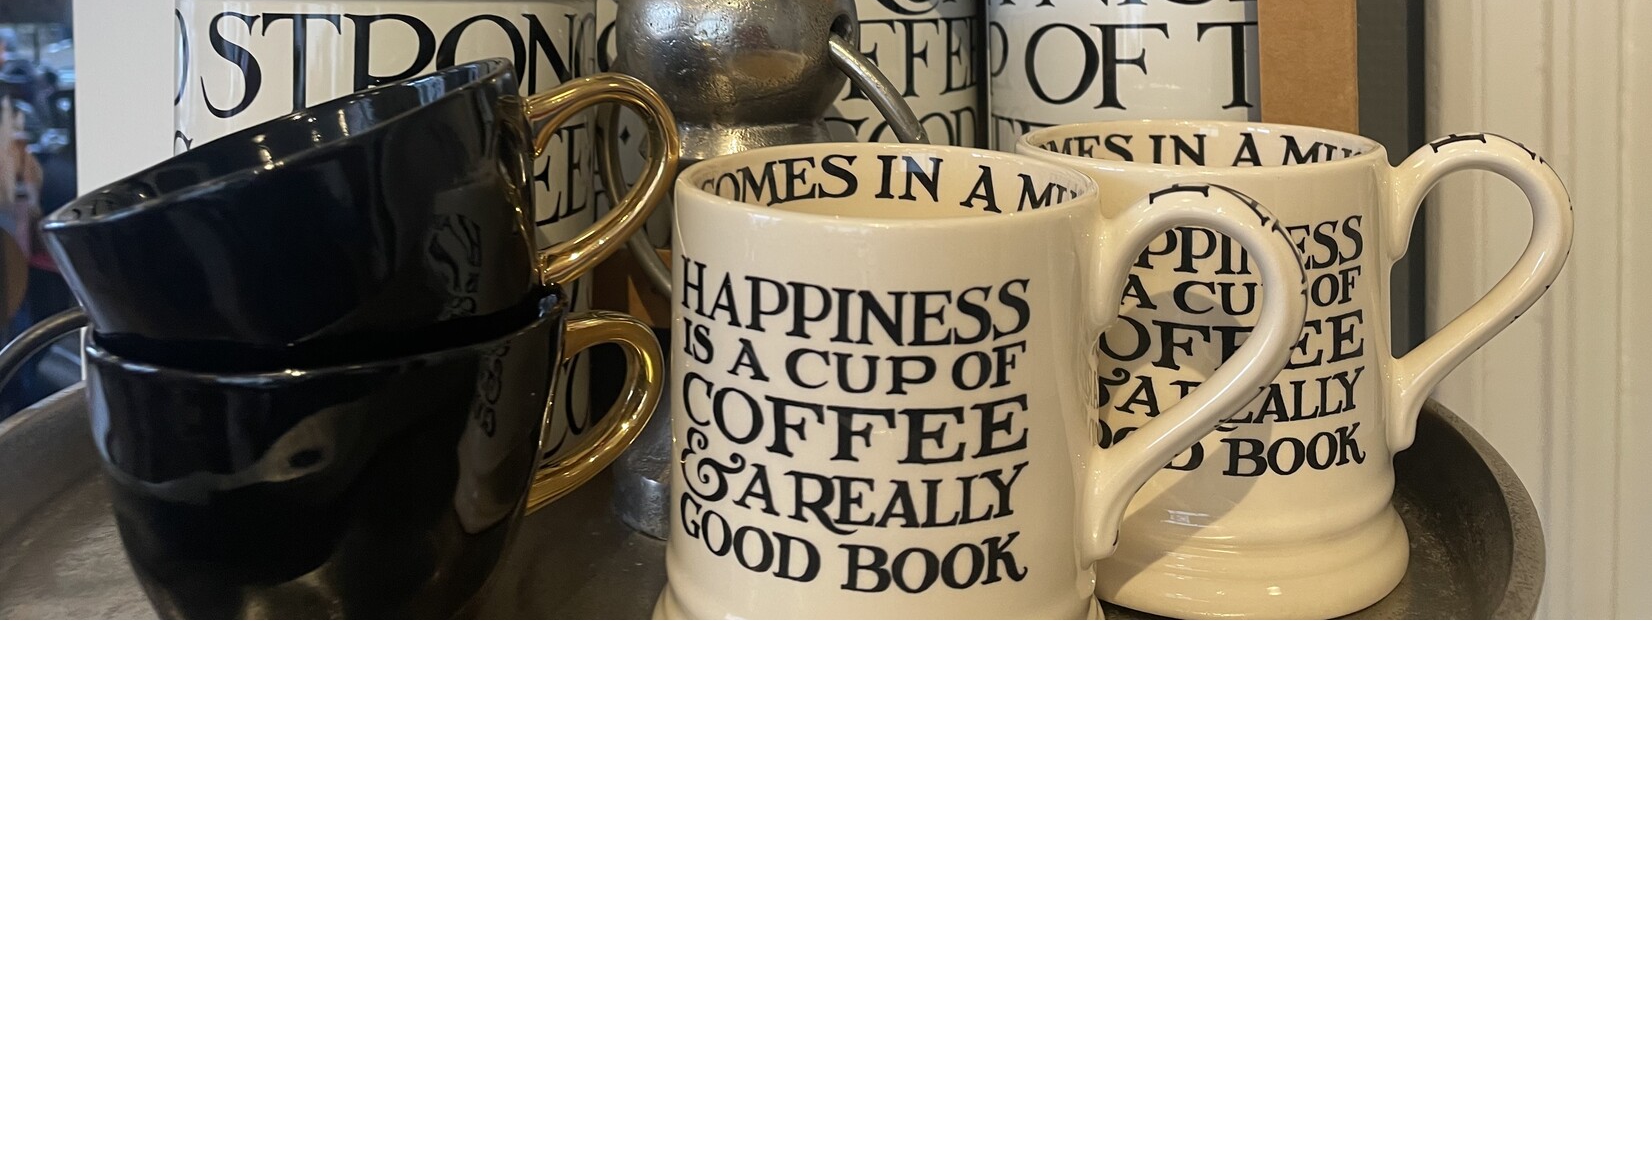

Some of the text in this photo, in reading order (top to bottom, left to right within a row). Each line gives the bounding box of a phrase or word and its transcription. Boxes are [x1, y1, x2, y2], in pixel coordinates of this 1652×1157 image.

[1025, 22, 1169, 111] OF
[875, 154, 944, 203] IN
[960, 164, 1002, 213] A
[1149, 134, 1207, 166] IN
[1232, 132, 1263, 166] A
[681, 255, 1031, 346] HAPPINESS
[1310, 265, 1361, 307] OF
[683, 318, 1026, 395] IS A CUP OF
[682, 372, 1030, 465] COFFEE
[1220, 422, 1366, 477] BOOK
[681, 426, 746, 503] &
[783, 460, 1030, 536] REALLY
[680, 491, 1028, 594] GOOD BOOK
